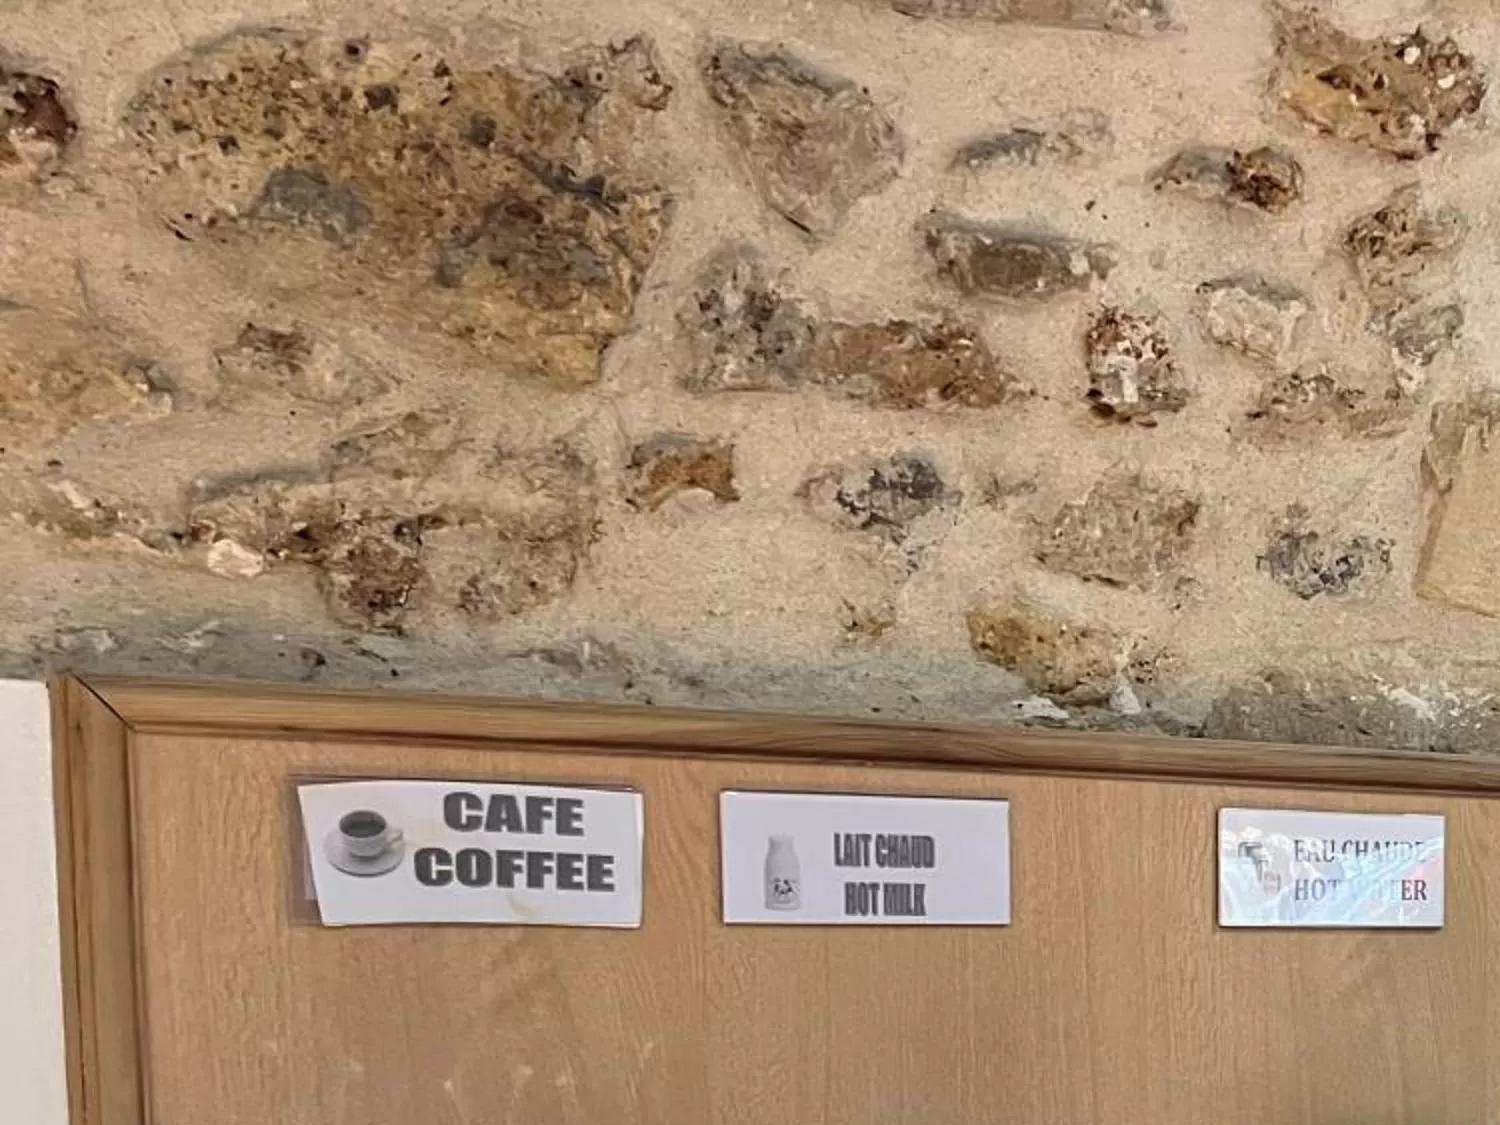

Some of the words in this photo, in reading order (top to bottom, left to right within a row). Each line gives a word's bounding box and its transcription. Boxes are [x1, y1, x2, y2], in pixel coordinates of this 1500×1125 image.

[443, 791, 585, 837] CAFE
[833, 832, 872, 867] LAIT
[875, 833, 935, 868] CHAUD
[1294, 838, 1335, 863] EAU
[413, 847, 616, 892] COFFEE
[844, 881, 880, 916] HOT
[883, 882, 926, 916] MILK
[1294, 879, 1340, 901] HOT
